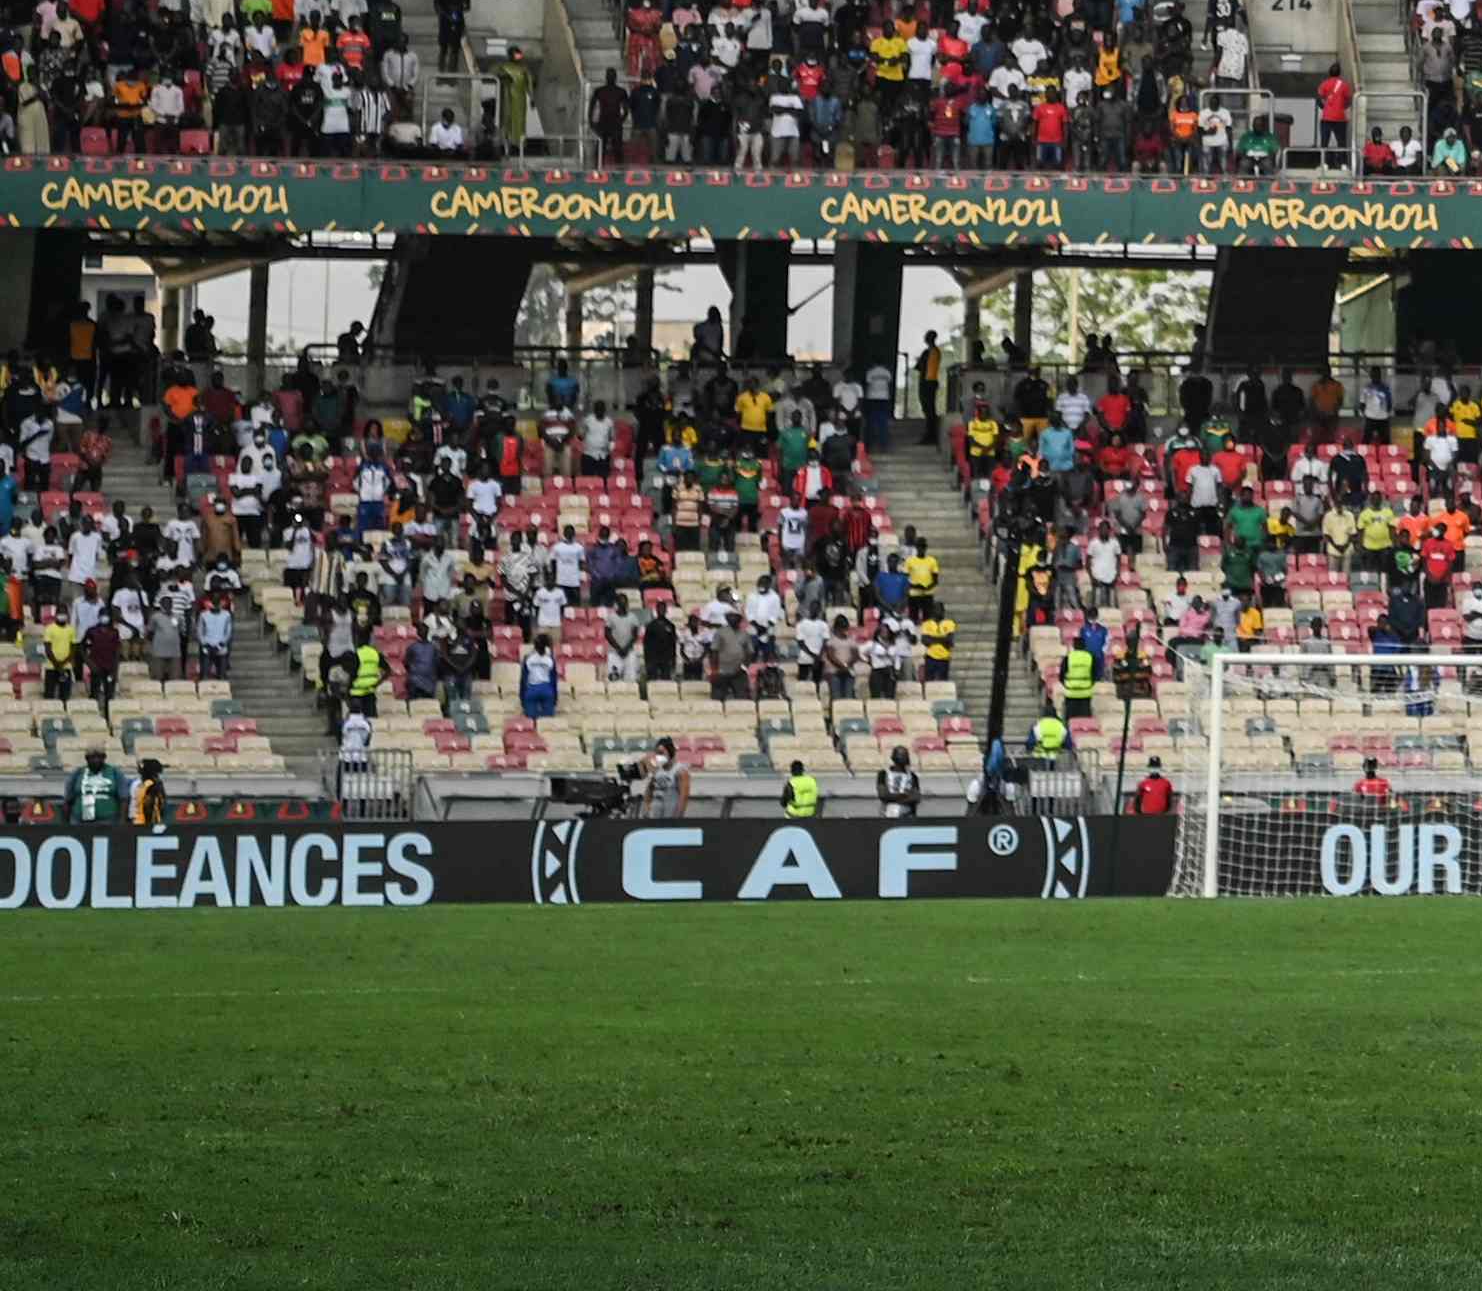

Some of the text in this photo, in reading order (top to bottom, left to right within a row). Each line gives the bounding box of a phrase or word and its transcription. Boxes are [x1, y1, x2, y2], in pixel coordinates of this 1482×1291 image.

[0, 823, 436, 908] DOLÉANCES
[621, 825, 958, 900] CAF
[1320, 823, 1463, 897] OUR
